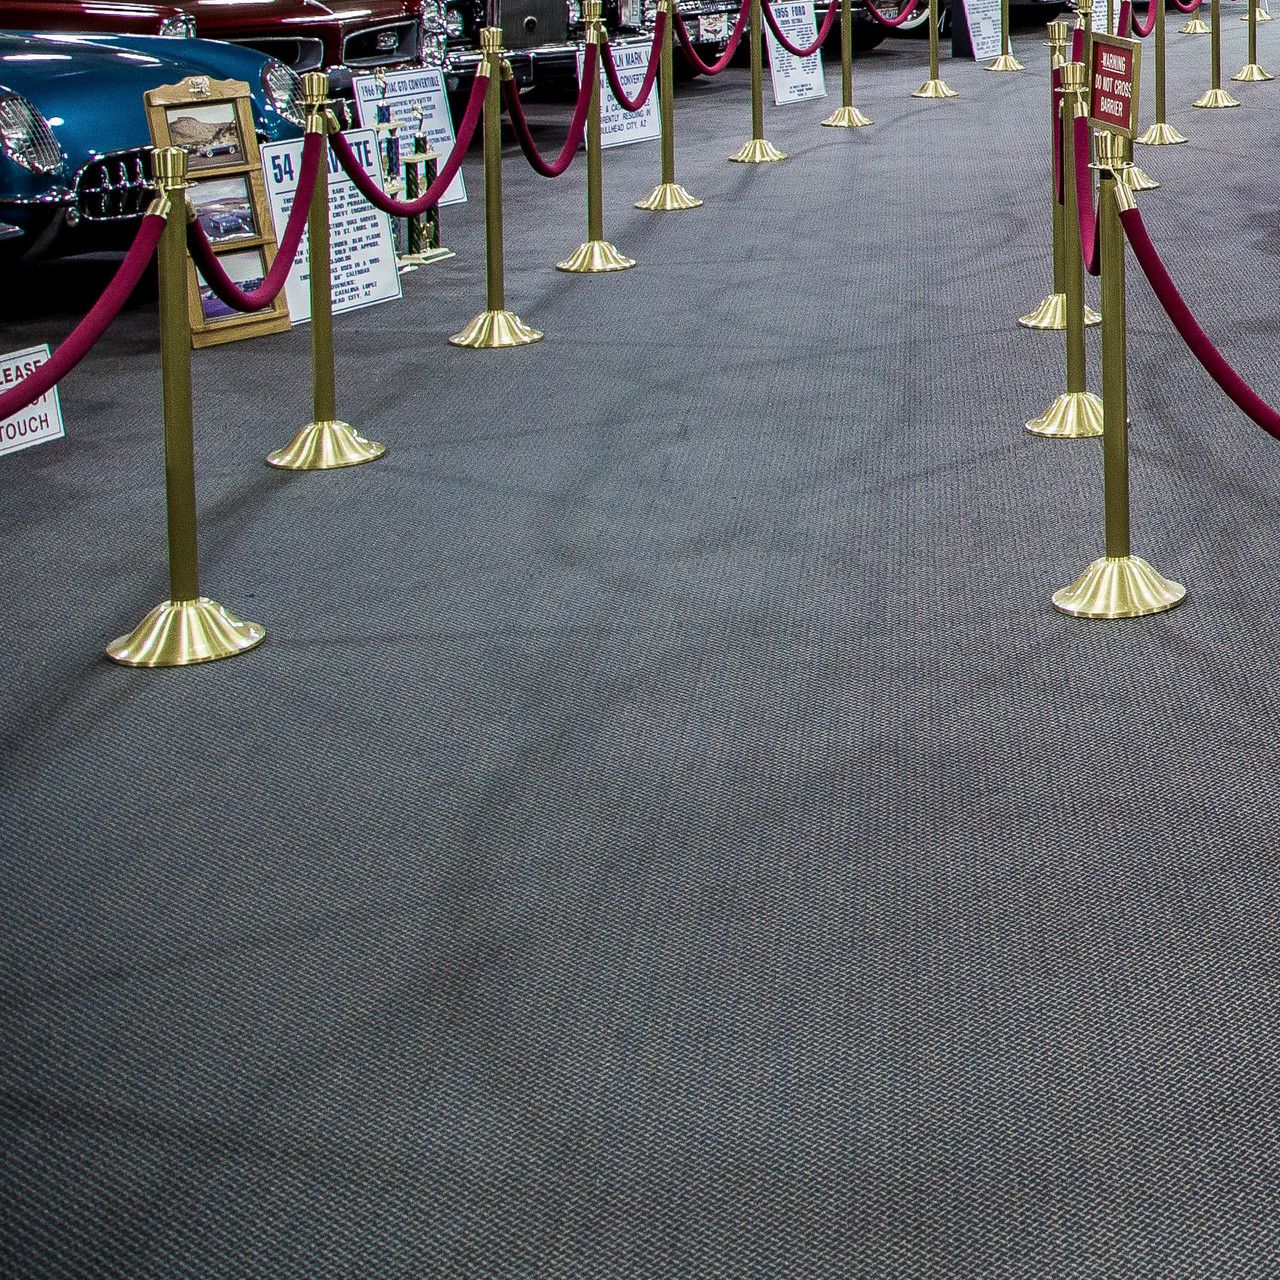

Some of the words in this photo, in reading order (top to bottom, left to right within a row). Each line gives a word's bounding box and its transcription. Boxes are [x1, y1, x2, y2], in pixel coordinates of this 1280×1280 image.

[774, 6, 789, 18] 1955
[792, 6, 806, 17] FORD
[625, 52, 644, 66] MARK
[1101, 52, 1126, 72] WARNING
[398, 81, 408, 92] GTO
[408, 76, 440, 90] CONVERTIBLE
[1094, 73, 1102, 90] DO
[1102, 76, 1114, 93] NOT
[1114, 79, 1132, 98] CROSS
[1100, 96, 1123, 118] BARRIER
[600, 123, 624, 135] ULLHEAD
[640, 120, 646, 128] AZ
[271, 153, 294, 184] 54
